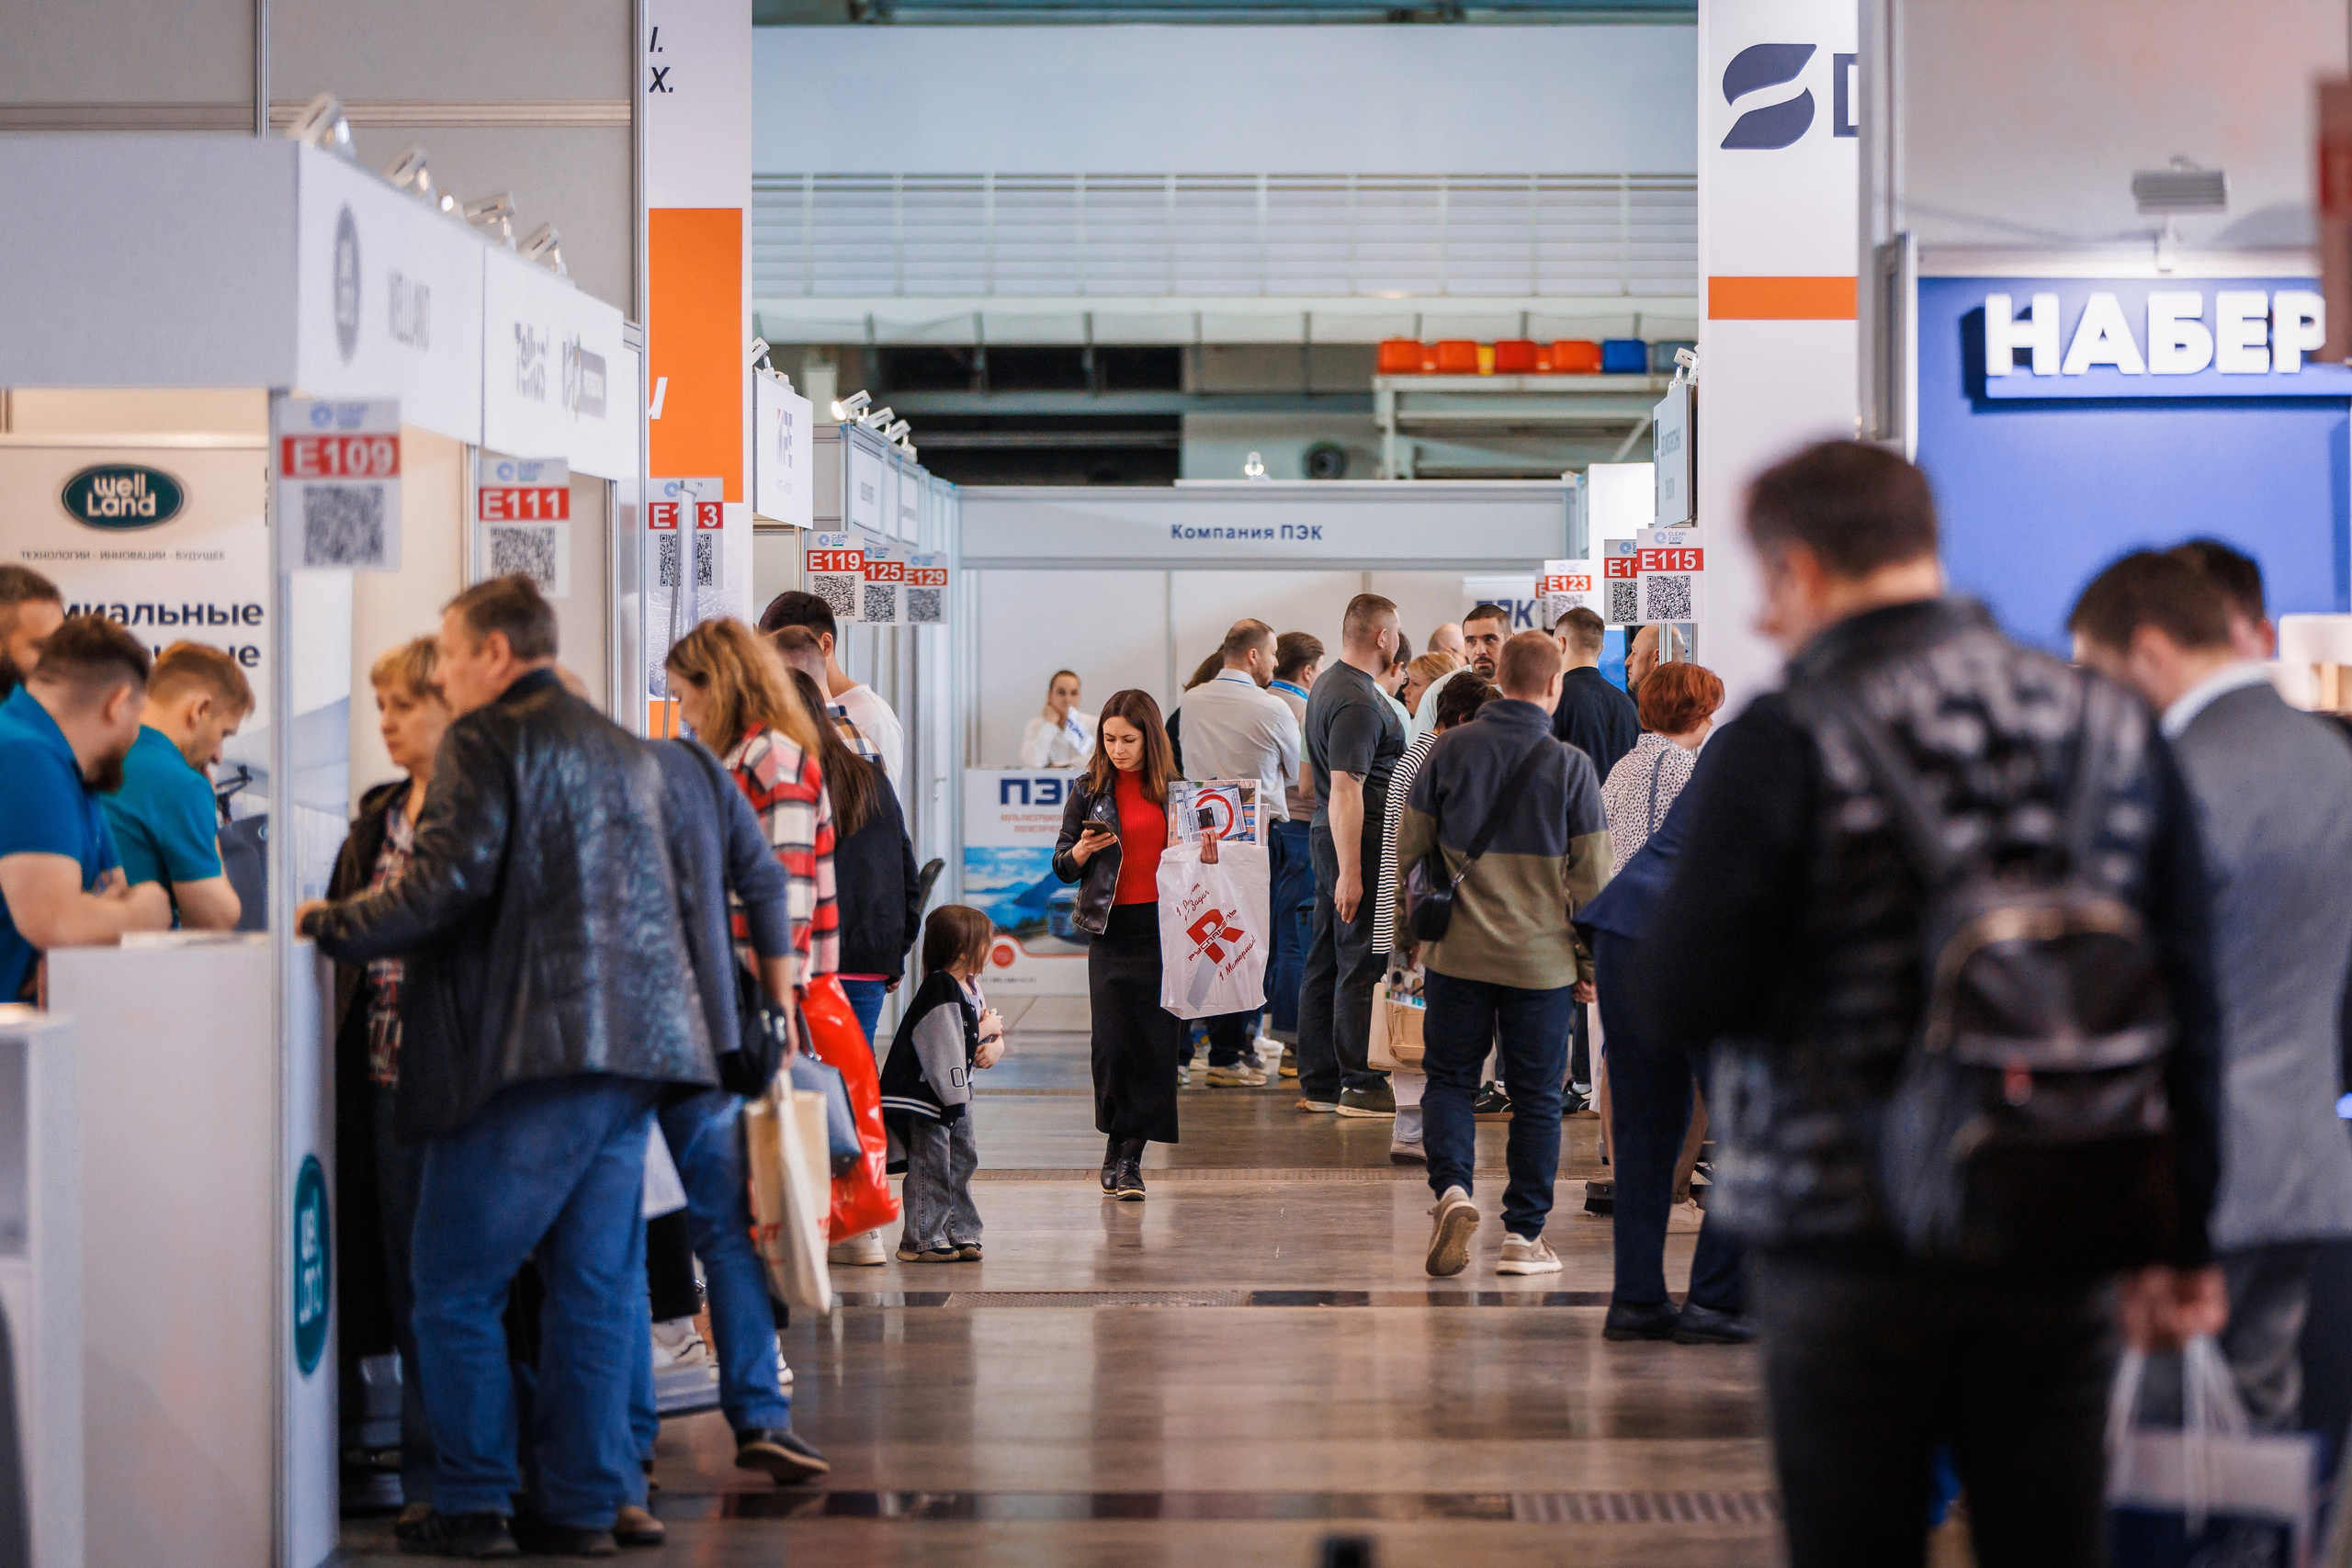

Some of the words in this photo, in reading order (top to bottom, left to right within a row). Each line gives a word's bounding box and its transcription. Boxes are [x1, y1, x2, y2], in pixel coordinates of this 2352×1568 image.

[293, 439, 394, 477] E109
[482, 490, 562, 520] E111
[1170, 524, 1274, 540] Компания
[1281, 524, 1323, 541] ПЭК
[21, 550, 90, 560] ТЕХНОЛОГИИ
[99, 550, 166, 560] ИННОВАЦИИ
[175, 550, 225, 560] БУДУЩЕЕ
[808, 552, 861, 570] E119
[1641, 550, 1697, 570] E115
[864, 563, 901, 581] 125
[1608, 559, 1637, 577] E1
[904, 570, 945, 585] E129
[1548, 576, 1589, 592] E123
[1476, 599, 1536, 628] ЭК
[1001, 778, 1077, 807] ПЭ
[1188, 909, 1238, 962] РУСПАНЕЛЬ
